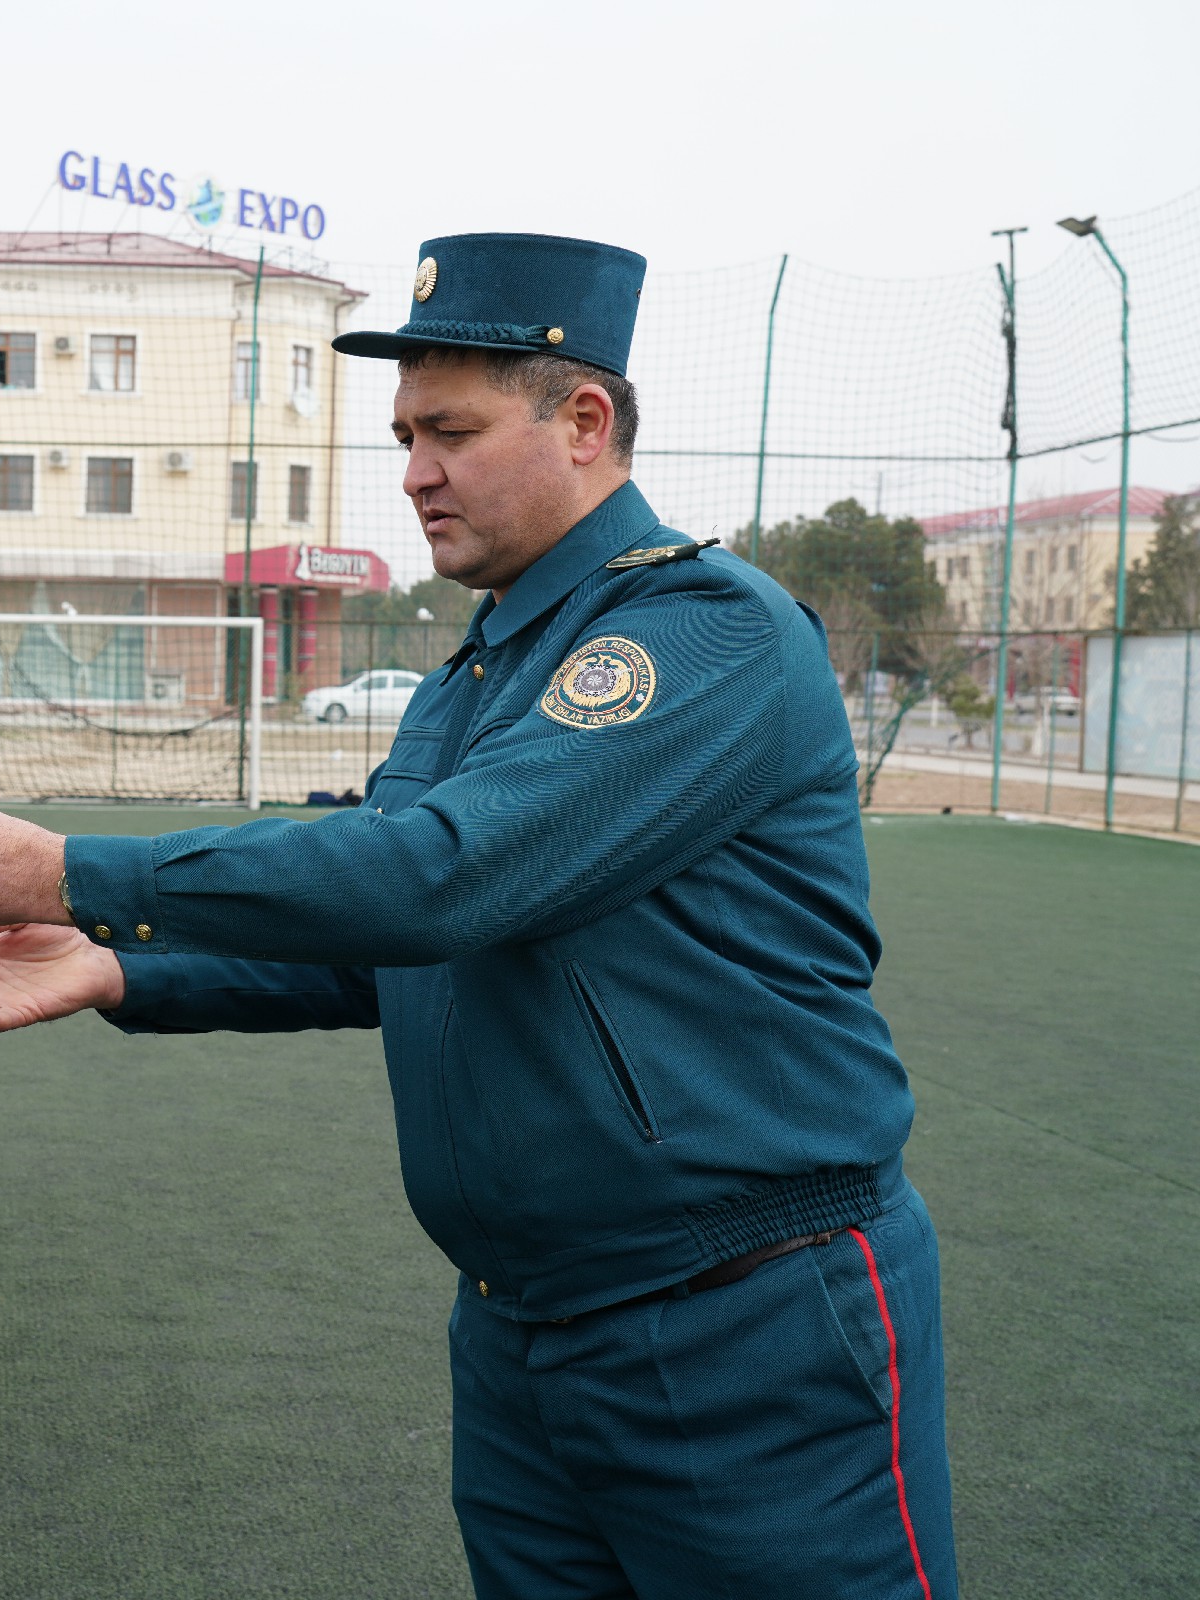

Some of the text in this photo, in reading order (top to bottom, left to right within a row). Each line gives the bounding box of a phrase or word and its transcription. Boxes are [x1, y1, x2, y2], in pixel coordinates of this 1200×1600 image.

[59, 150, 326, 240] GLASS EXPO
[610, 641, 650, 693] RESPUBLIKASI
[553, 705, 584, 723] ISHLAR
[586, 706, 632, 724] VAZIRLIGI
